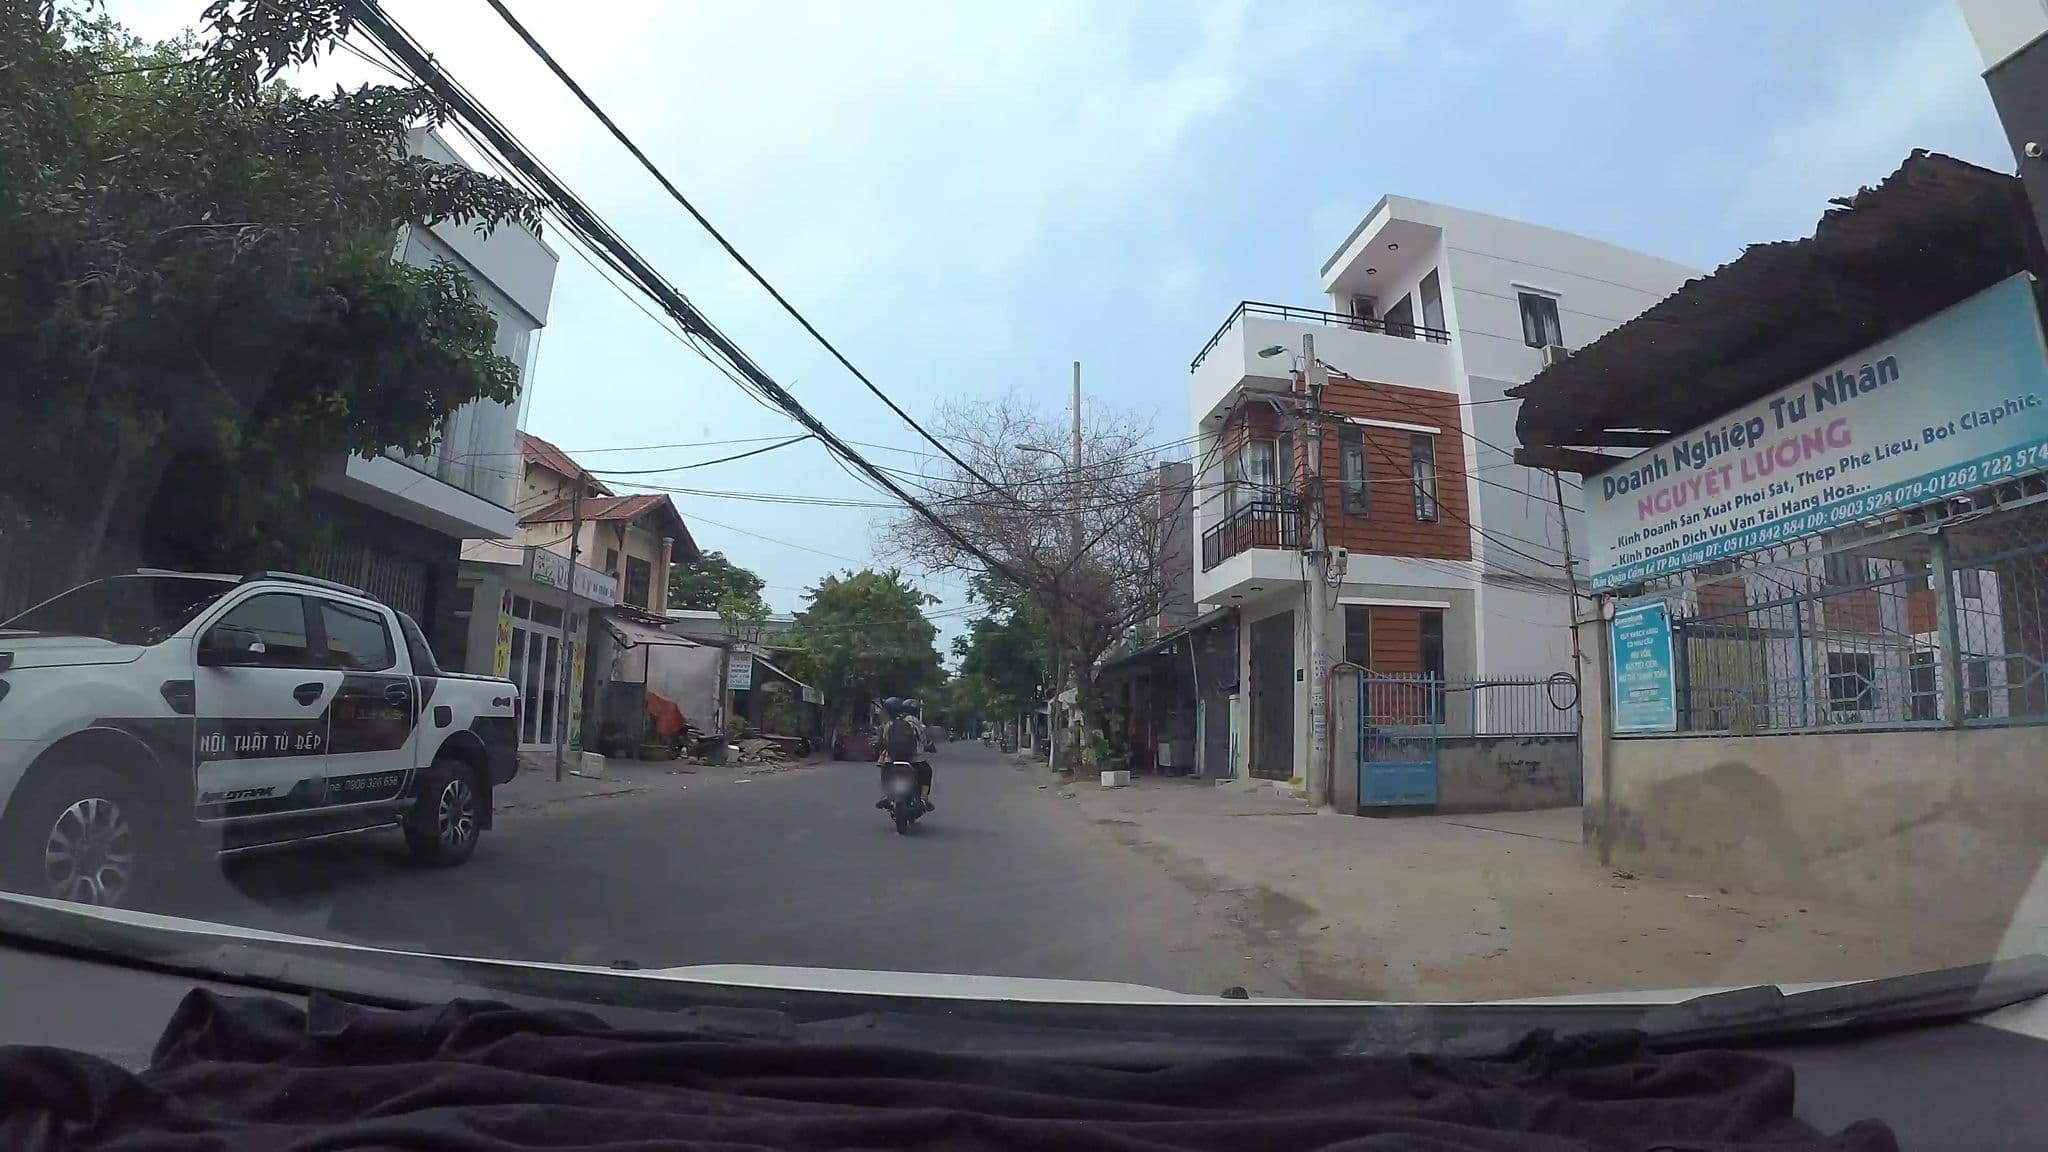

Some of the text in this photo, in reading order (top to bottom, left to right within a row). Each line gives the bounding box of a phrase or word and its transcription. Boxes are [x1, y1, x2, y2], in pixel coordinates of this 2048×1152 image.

[1602, 453, 1668, 501] Doanh
[1672, 414, 1765, 471] Nghiệp
[1812, 354, 1899, 413] Nhân
[1656, 558, 1668, 570] TP
[1759, 525, 1780, 543] 842
[1782, 517, 1804, 536] 884
[1830, 501, 1863, 520] 0903
[1866, 491, 1893, 511] 528
[1981, 455, 2012, 478] 722
[1617, 531, 1641, 548] Kinh
[1643, 519, 1678, 540] Doanh
[1619, 550, 1642, 566] Kinh
[1645, 538, 1679, 557] Doanh
[200, 732, 226, 756] NỘI
